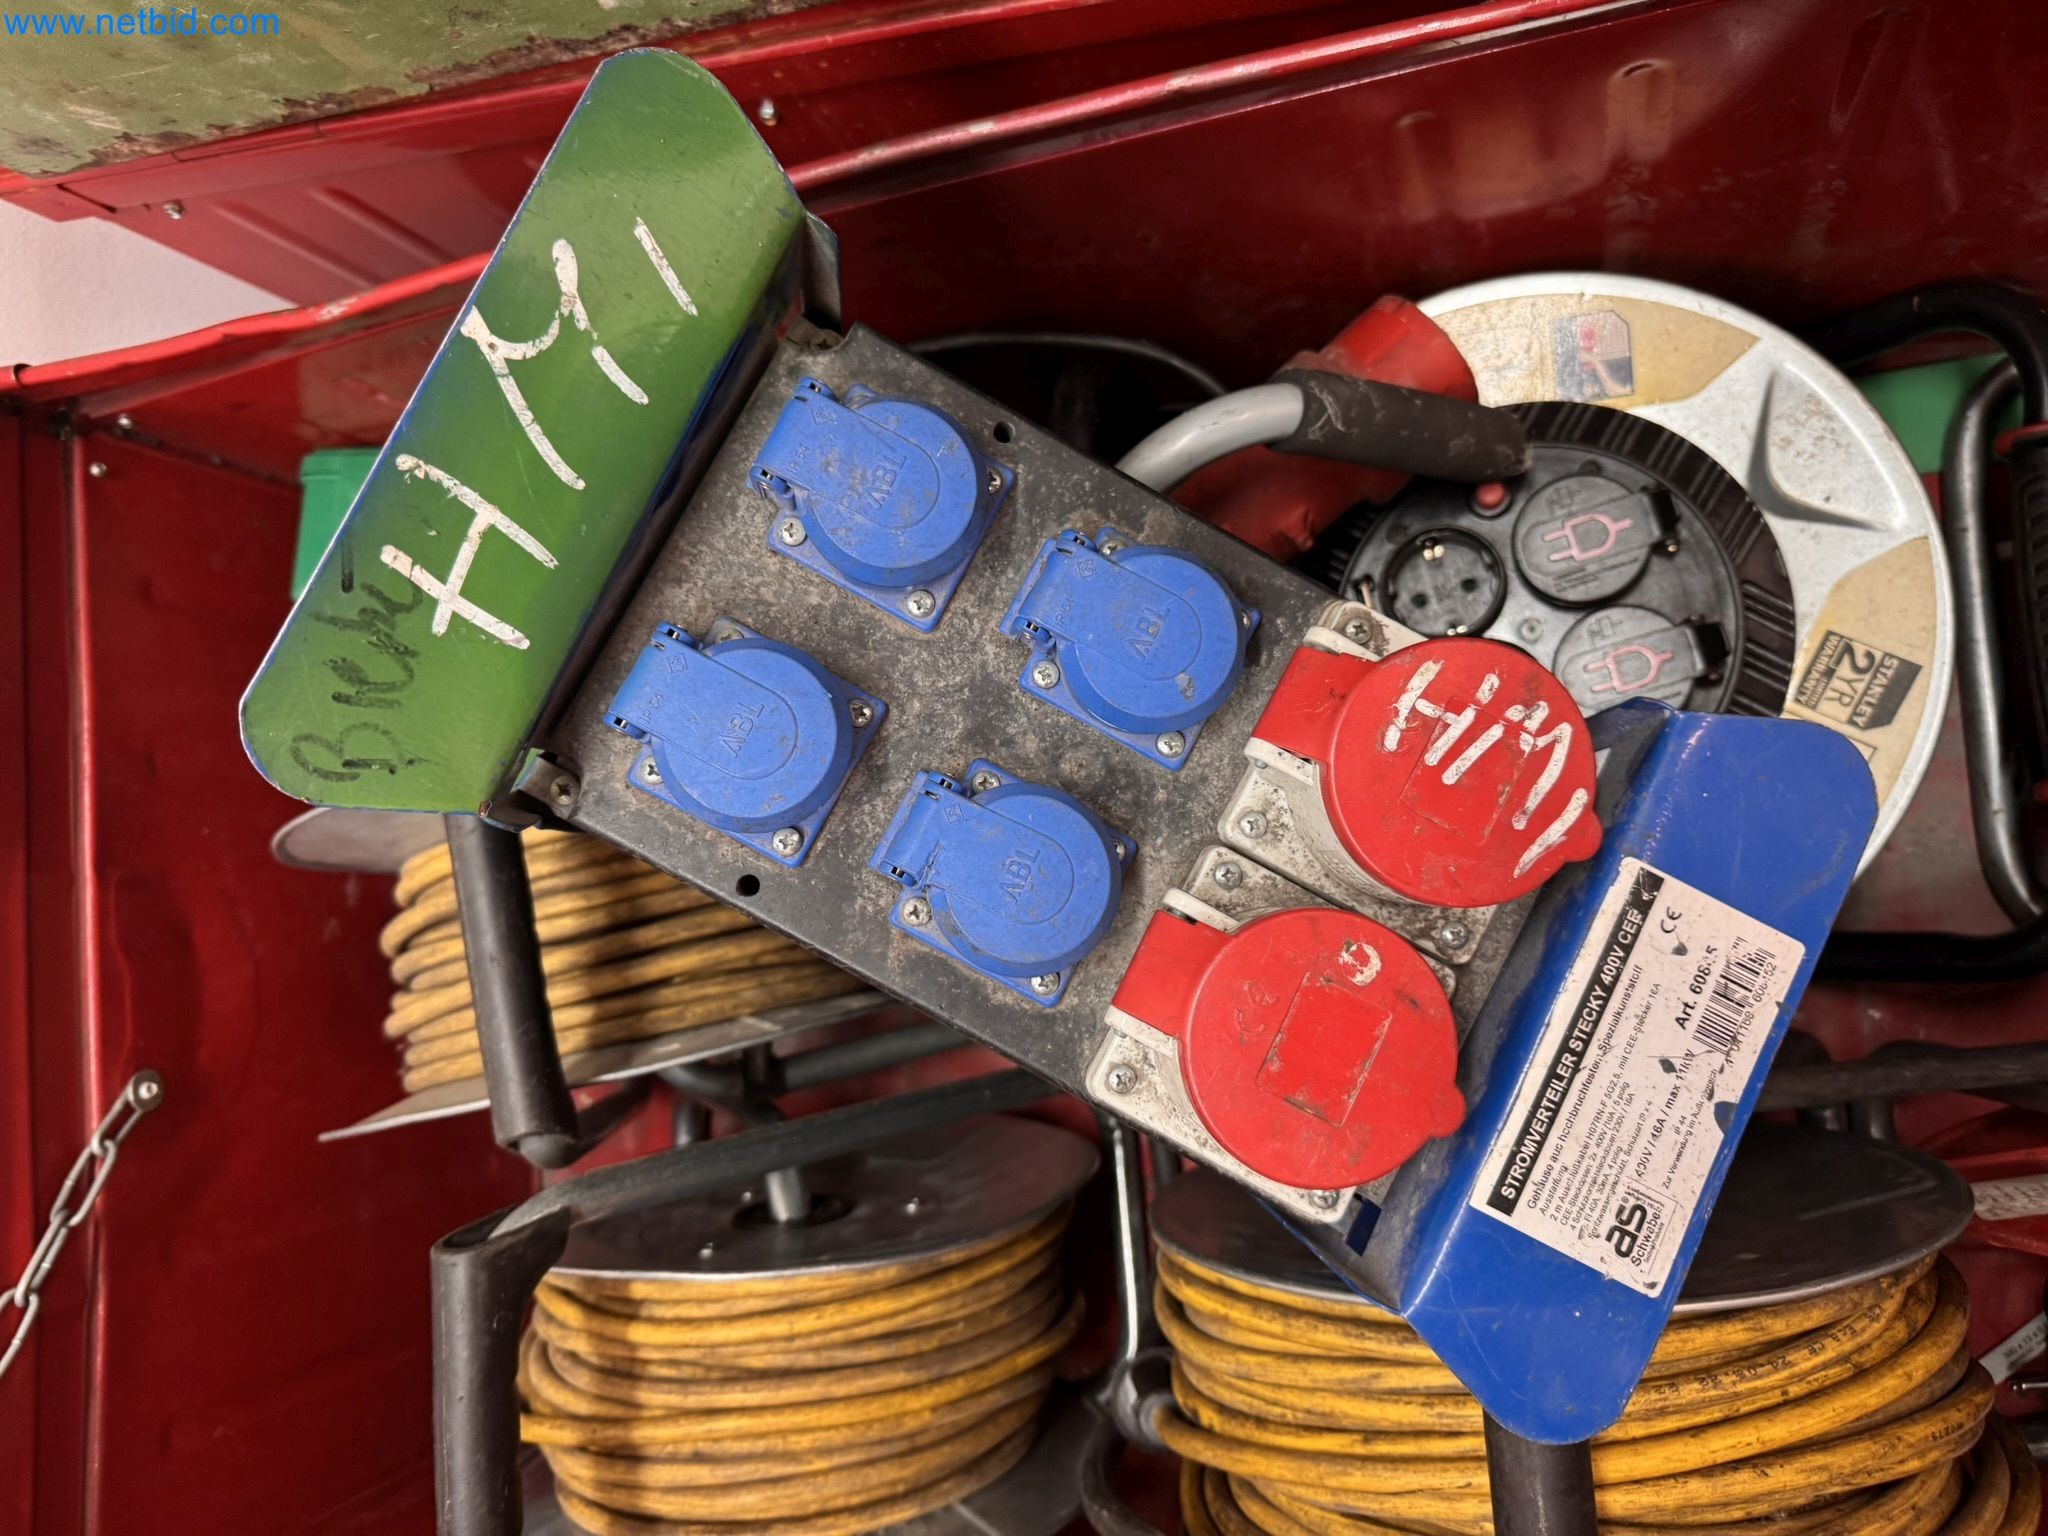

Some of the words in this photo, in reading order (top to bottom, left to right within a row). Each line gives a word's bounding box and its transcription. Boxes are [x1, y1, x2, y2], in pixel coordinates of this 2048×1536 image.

[858, 446, 910, 510] ABL
[1122, 597, 1173, 660] ABL
[1796, 633, 1840, 707] WARRANTY
[1851, 655, 1897, 729] STANLEY
[713, 694, 766, 759] ABL
[992, 840, 1045, 905] ABL
[1673, 996, 1696, 1029] Art.
[1500, 1050, 1577, 1201] STROMVERTEILER
[1567, 984, 1607, 1052] STECKY
[1598, 944, 1625, 985] 400V
[1616, 908, 1641, 945] CEE
[1526, 1161, 1554, 1210] Gehäuse
[1548, 1142, 1563, 1163] aus
[1597, 964, 1645, 1053] Spezialkunststoff
[1555, 1204, 1562, 1213] m
[1586, 1100, 1608, 1140] H07RN-F
[1617, 1055, 1628, 1069] mit
[1624, 999, 1653, 1055] CEE-Stecker
[1588, 1151, 1597, 1161] 2x
[1594, 1128, 1607, 1148] 400V
[1616, 1080, 1630, 1100] polig
[1612, 1112, 1625, 1132] 230V
[1664, 1083, 1680, 1109] max
[1609, 1145, 1623, 1164] polig
[1661, 1174, 1672, 1189] Zur
[1668, 1129, 1693, 1175] Verwendung
[1688, 1119, 1696, 1129] im
[1601, 1196, 1649, 1259] as
[1629, 1208, 1662, 1267] Schwabe
